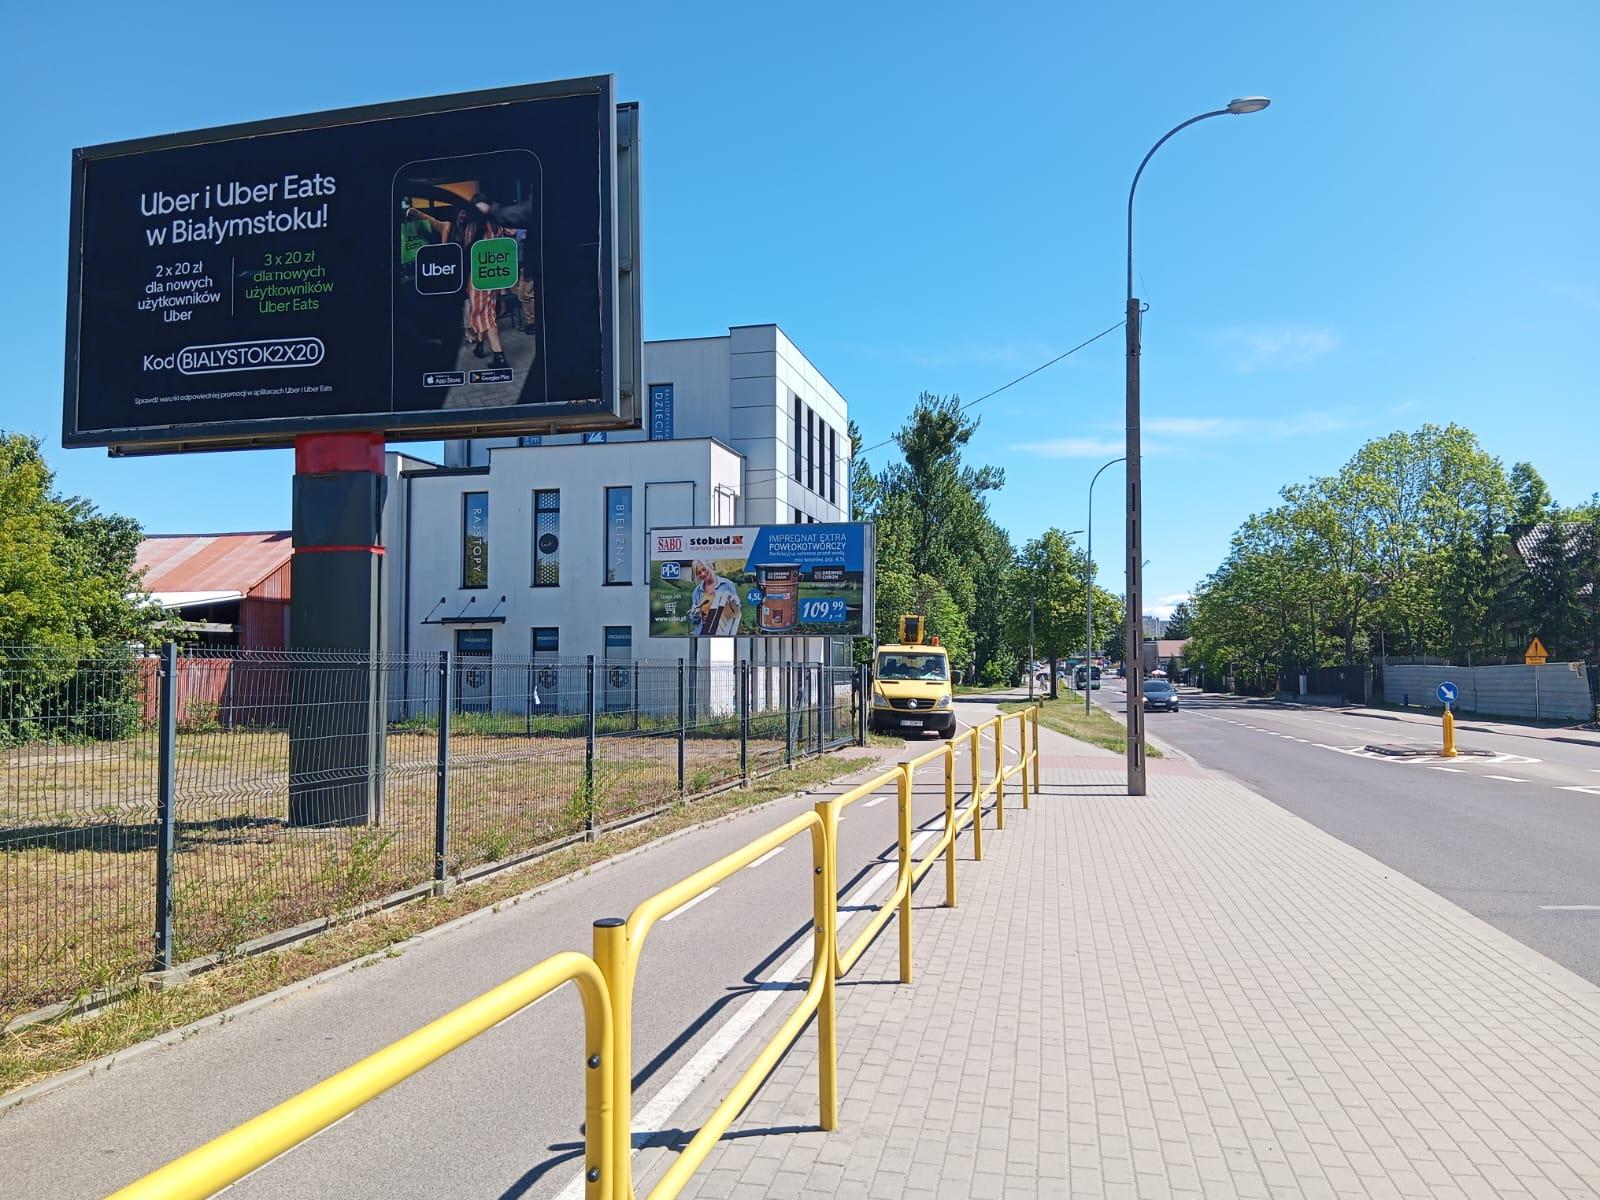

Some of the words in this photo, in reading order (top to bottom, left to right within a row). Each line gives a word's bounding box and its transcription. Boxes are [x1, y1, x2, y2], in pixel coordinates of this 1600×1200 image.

[140, 191, 200, 217] Uber
[205, 185, 211, 208] i
[216, 181, 278, 207] Uber
[283, 173, 337, 200] Eats
[146, 227, 167, 246] w
[172, 203, 328, 245] Białymstoku!
[264, 254, 272, 266] 3
[275, 256, 283, 265] x
[285, 252, 302, 265] 20
[304, 250, 315, 263] zł
[478, 251, 510, 265] Uber
[155, 265, 163, 277] 2
[165, 266, 173, 276] x
[174, 262, 191, 276] 20
[192, 260, 203, 274] zł
[253, 269, 273, 283] dla
[275, 265, 326, 282] nowych
[422, 263, 457, 277] Uber
[478, 266, 511, 279] Eats
[145, 281, 164, 294] dla
[166, 276, 213, 291] nowych
[245, 281, 334, 301] użytkowników
[137, 291, 221, 310] użytkowników
[259, 301, 290, 313] Uber
[293, 298, 320, 311] Eats
[163, 310, 193, 323] Uber
[143, 353, 175, 371] Kod
[182, 343, 319, 369] BIALYSTOK2X20
[285, 386, 300, 394] Uber
[304, 385, 319, 393] Uber
[320, 384, 333, 392] Eats
[472, 507, 483, 572] RAJSTOPY
[615, 504, 625, 568] BIELIZNA
[690, 536, 731, 545] stobud
[769, 534, 817, 543] IMPREGNAT
[820, 533, 847, 542] EXTRA
[658, 538, 682, 551] SABO
[769, 541, 847, 551] POWŁOKOTWÓRCZY
[662, 564, 679, 576] PPG
[747, 593, 762, 602] 4,5L
